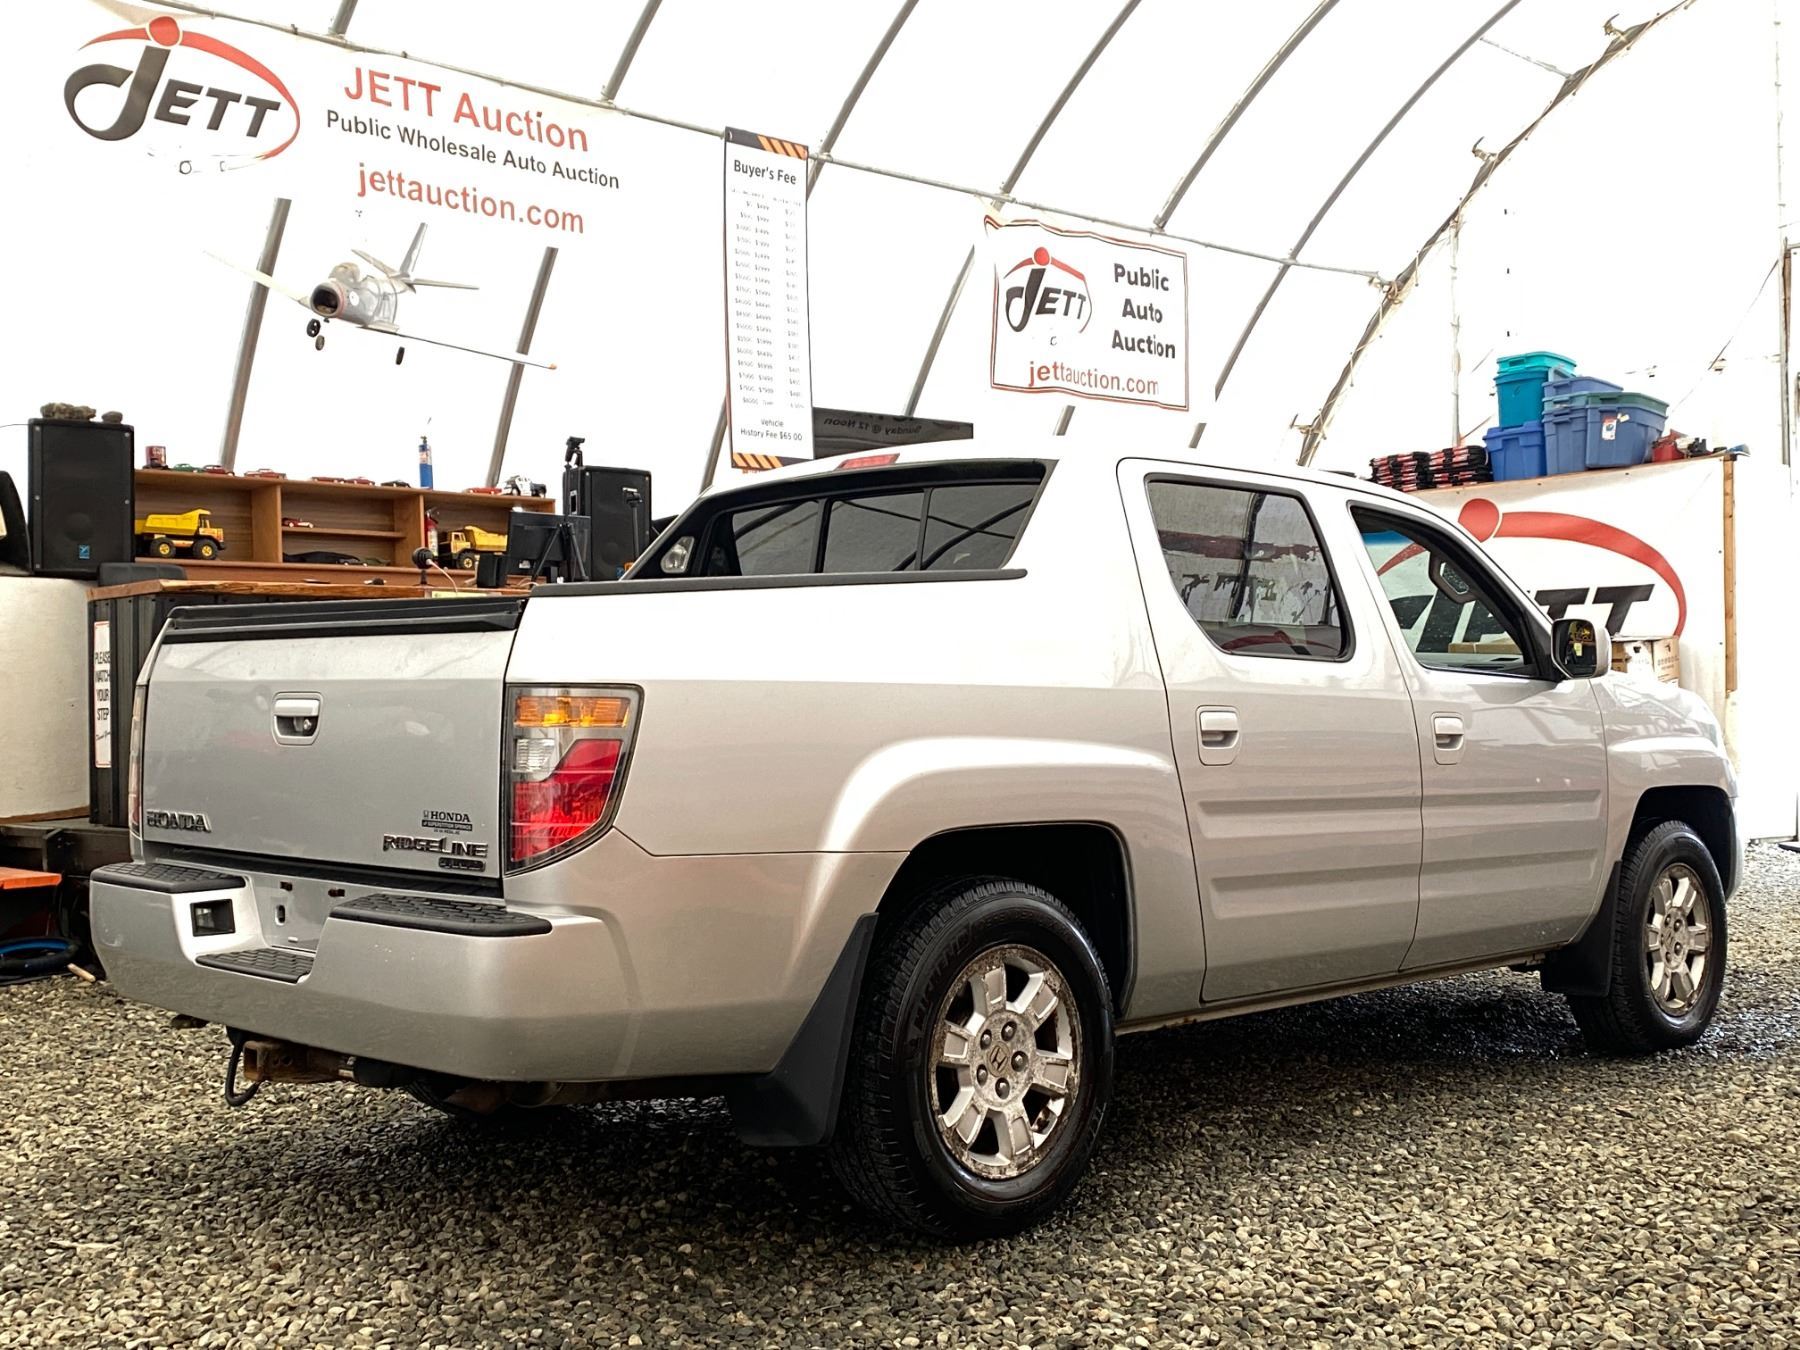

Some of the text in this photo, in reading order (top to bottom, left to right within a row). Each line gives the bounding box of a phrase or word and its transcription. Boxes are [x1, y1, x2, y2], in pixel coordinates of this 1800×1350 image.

[63, 45, 282, 141] JETT
[343, 66, 589, 153] JETT Auction
[327, 109, 620, 190] Public Wholesale Auto Auction
[733, 159, 797, 185] Buyer's Fee
[356, 162, 584, 234] jettauction.com
[1113, 262, 1170, 292] Public
[1004, 267, 1087, 333] JETT
[1121, 297, 1164, 324] Auto
[1111, 329, 1176, 360] Auction
[1028, 360, 1159, 395] jettauction.com
[740, 428, 764, 439] History
[765, 430, 778, 439] Fee
[94, 651, 111, 664] PLEASE
[96, 688, 110, 702] YOUR
[97, 707, 110, 721] STEP
[146, 808, 212, 833] HONDA
[430, 810, 472, 823] HONDA
[383, 833, 489, 859] RIDGELINE
